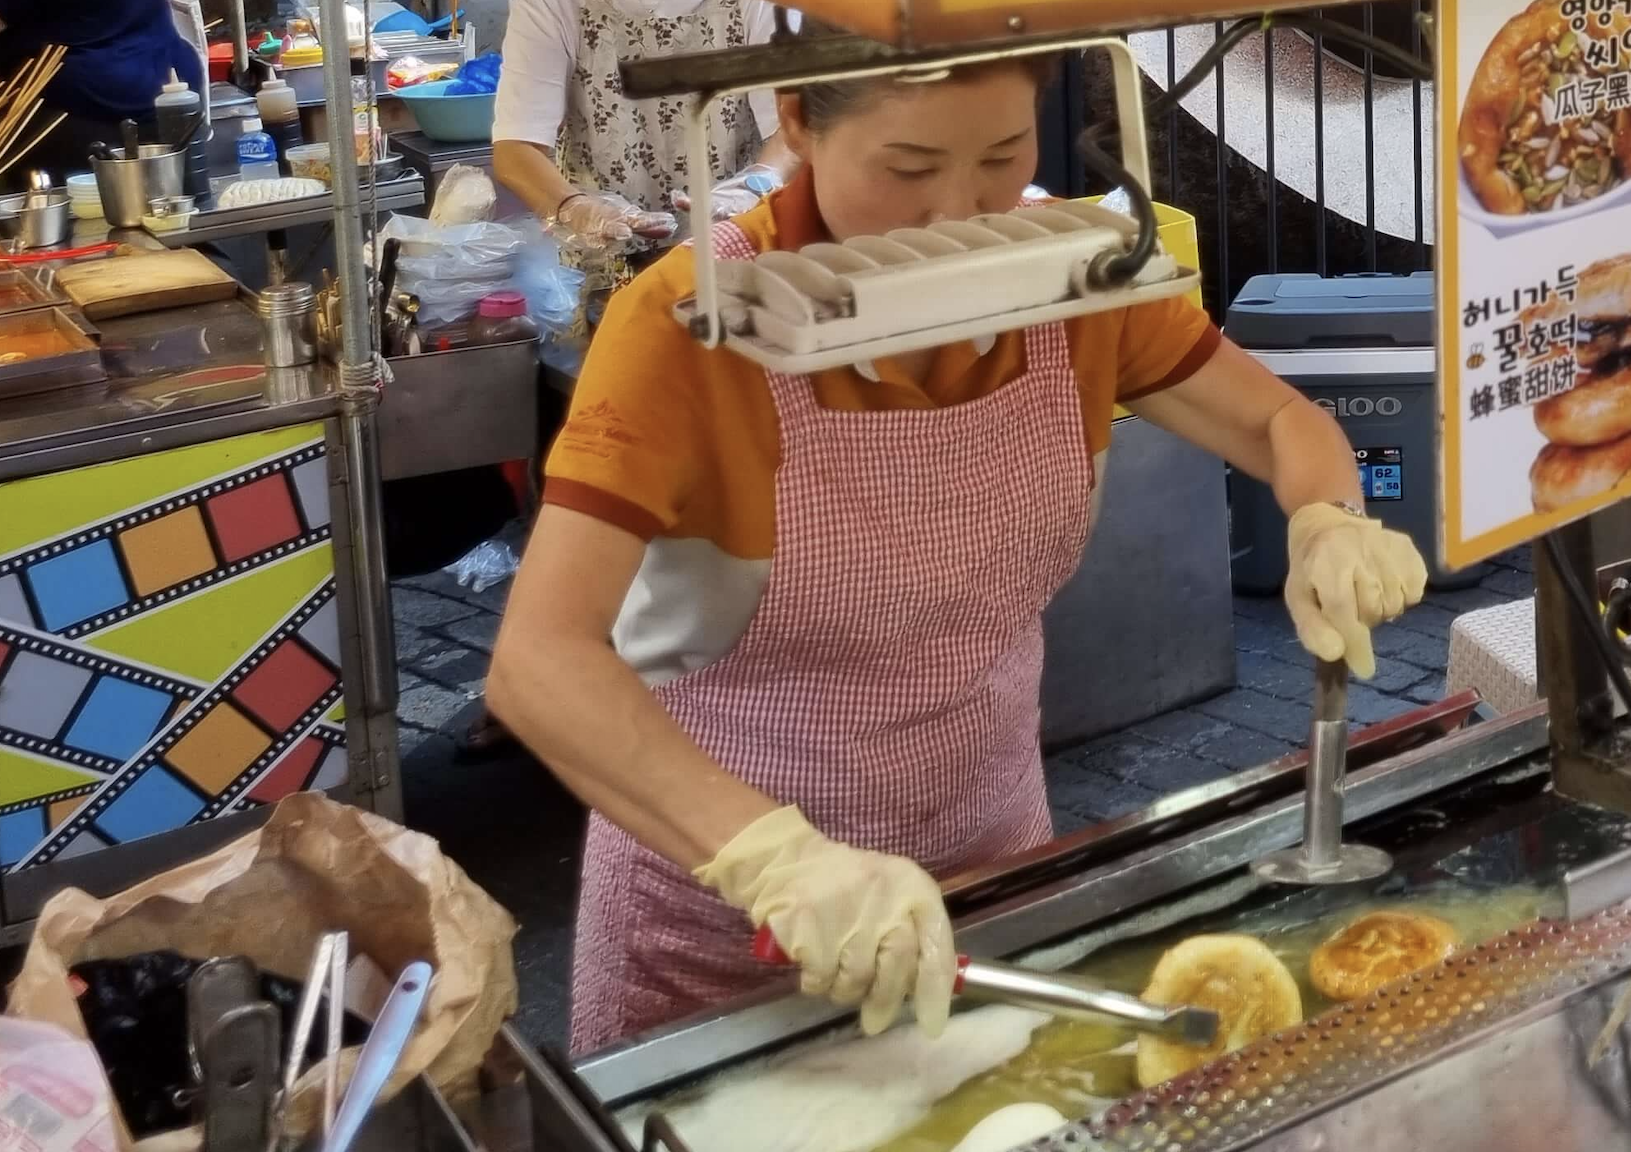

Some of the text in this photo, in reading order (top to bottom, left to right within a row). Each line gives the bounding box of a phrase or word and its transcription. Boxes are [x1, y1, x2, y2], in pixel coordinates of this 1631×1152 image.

[1463, 264, 1578, 327] 허니가득
[1493, 313, 1576, 372] 꿀호떡
[1469, 356, 1576, 421] 蜂蜜甜饼
[1375, 468, 1392, 478] 62
